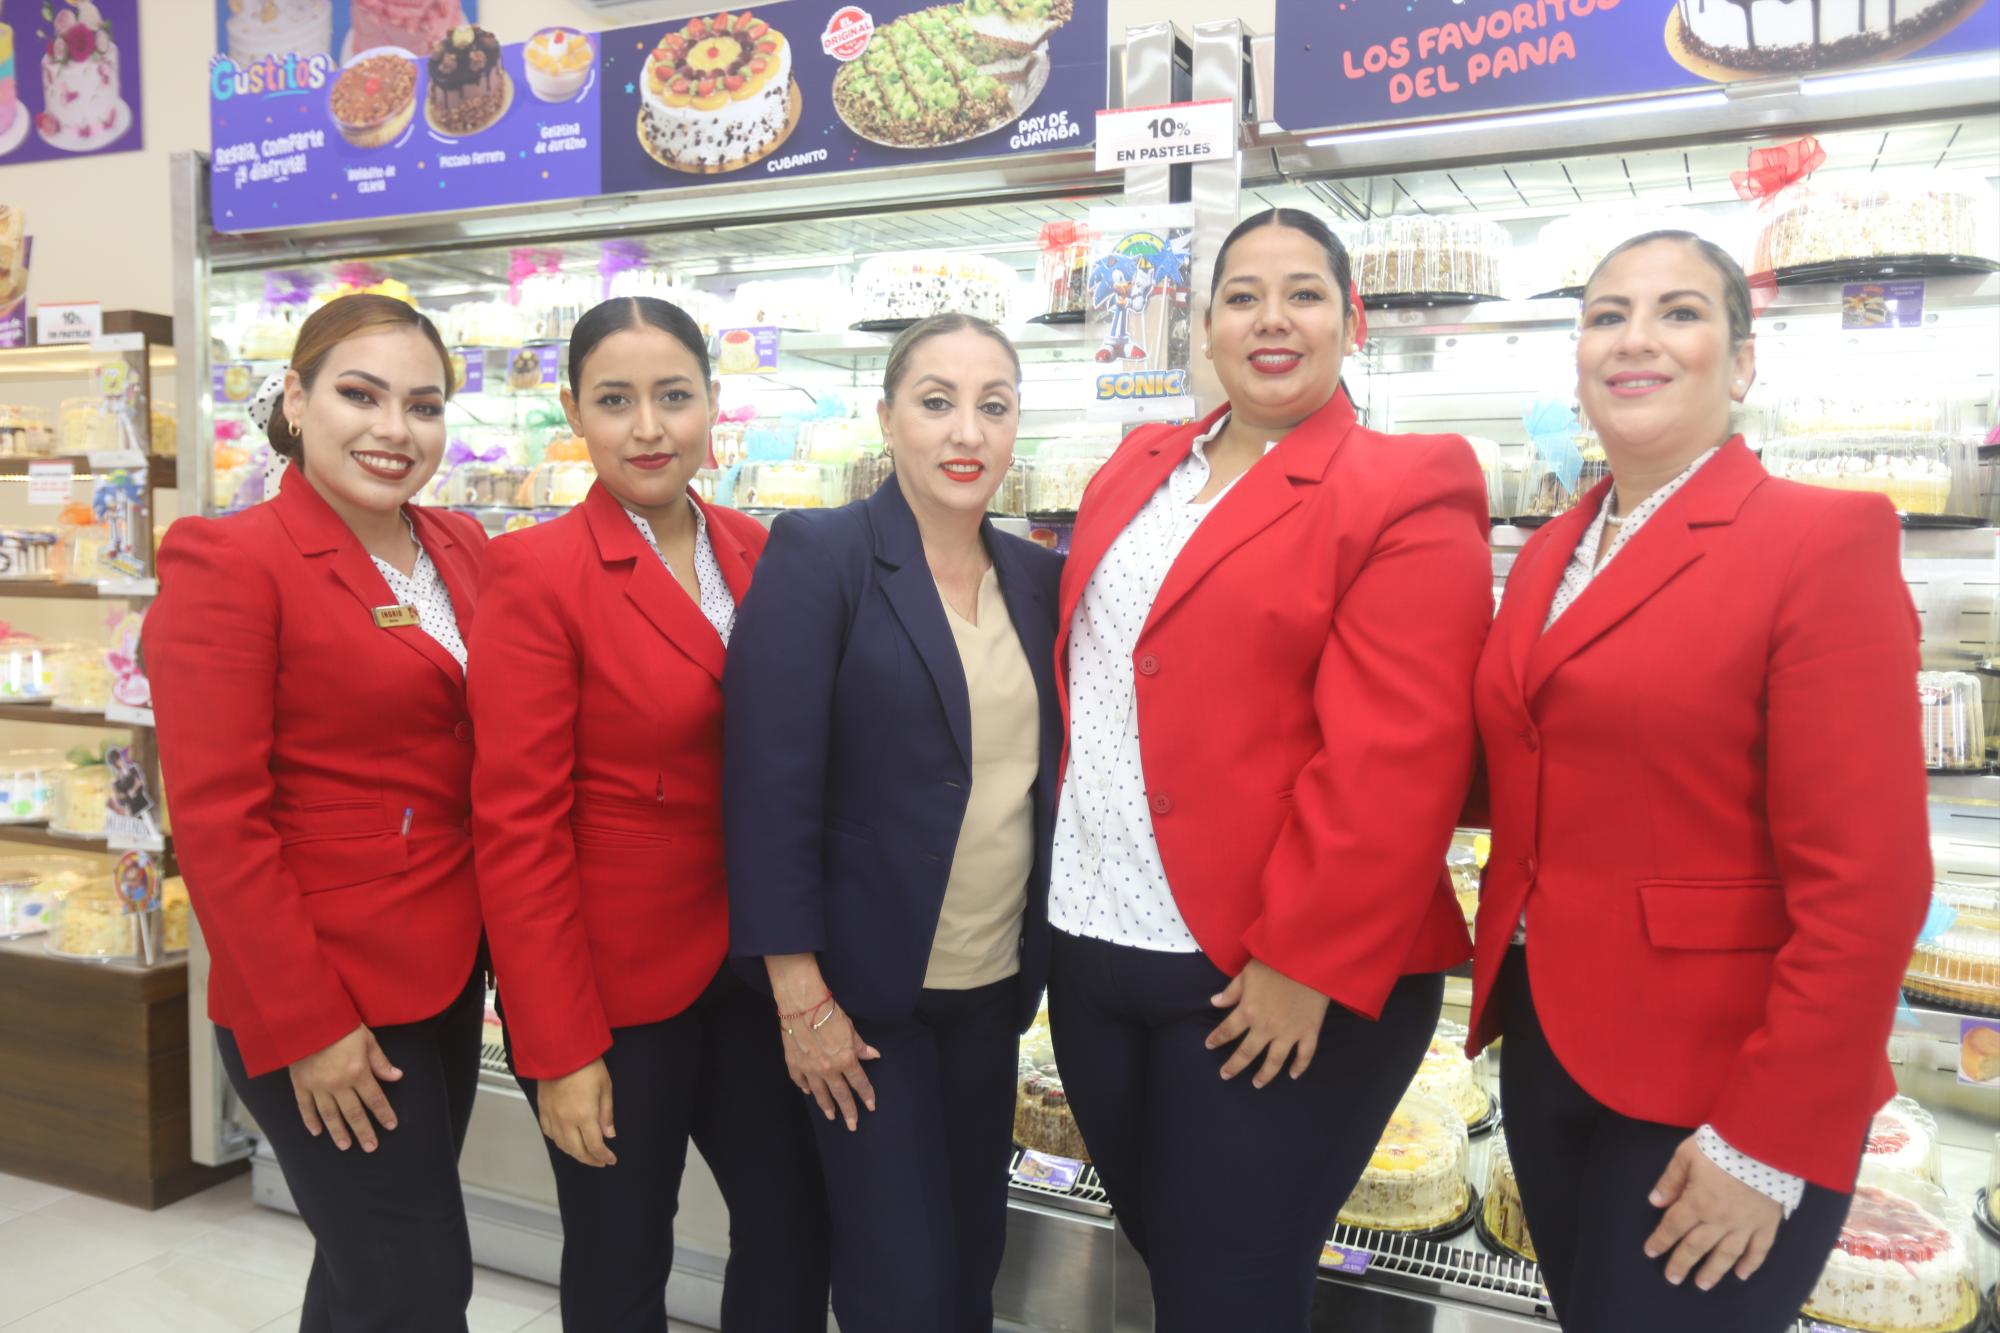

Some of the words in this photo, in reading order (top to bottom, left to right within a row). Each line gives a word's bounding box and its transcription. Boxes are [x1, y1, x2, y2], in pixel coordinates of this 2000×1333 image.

[824, 21, 871, 48] ORIGINAL
[839, 16, 854, 28] EL
[1343, 37, 1411, 79] LOS
[1389, 65, 1460, 104] DEL
[1467, 31, 1576, 85] PANA
[212, 55, 326, 101] Gustitos
[1019, 114, 1046, 134] PAY
[1049, 110, 1068, 128] DE
[1147, 117, 1191, 139] 10%
[1010, 122, 1080, 149] GUAYABA
[767, 148, 828, 172] CUBANITO
[1117, 149, 1136, 161] EN
[1140, 142, 1211, 160] PASTELES
[1098, 373, 1184, 399] SONIC
